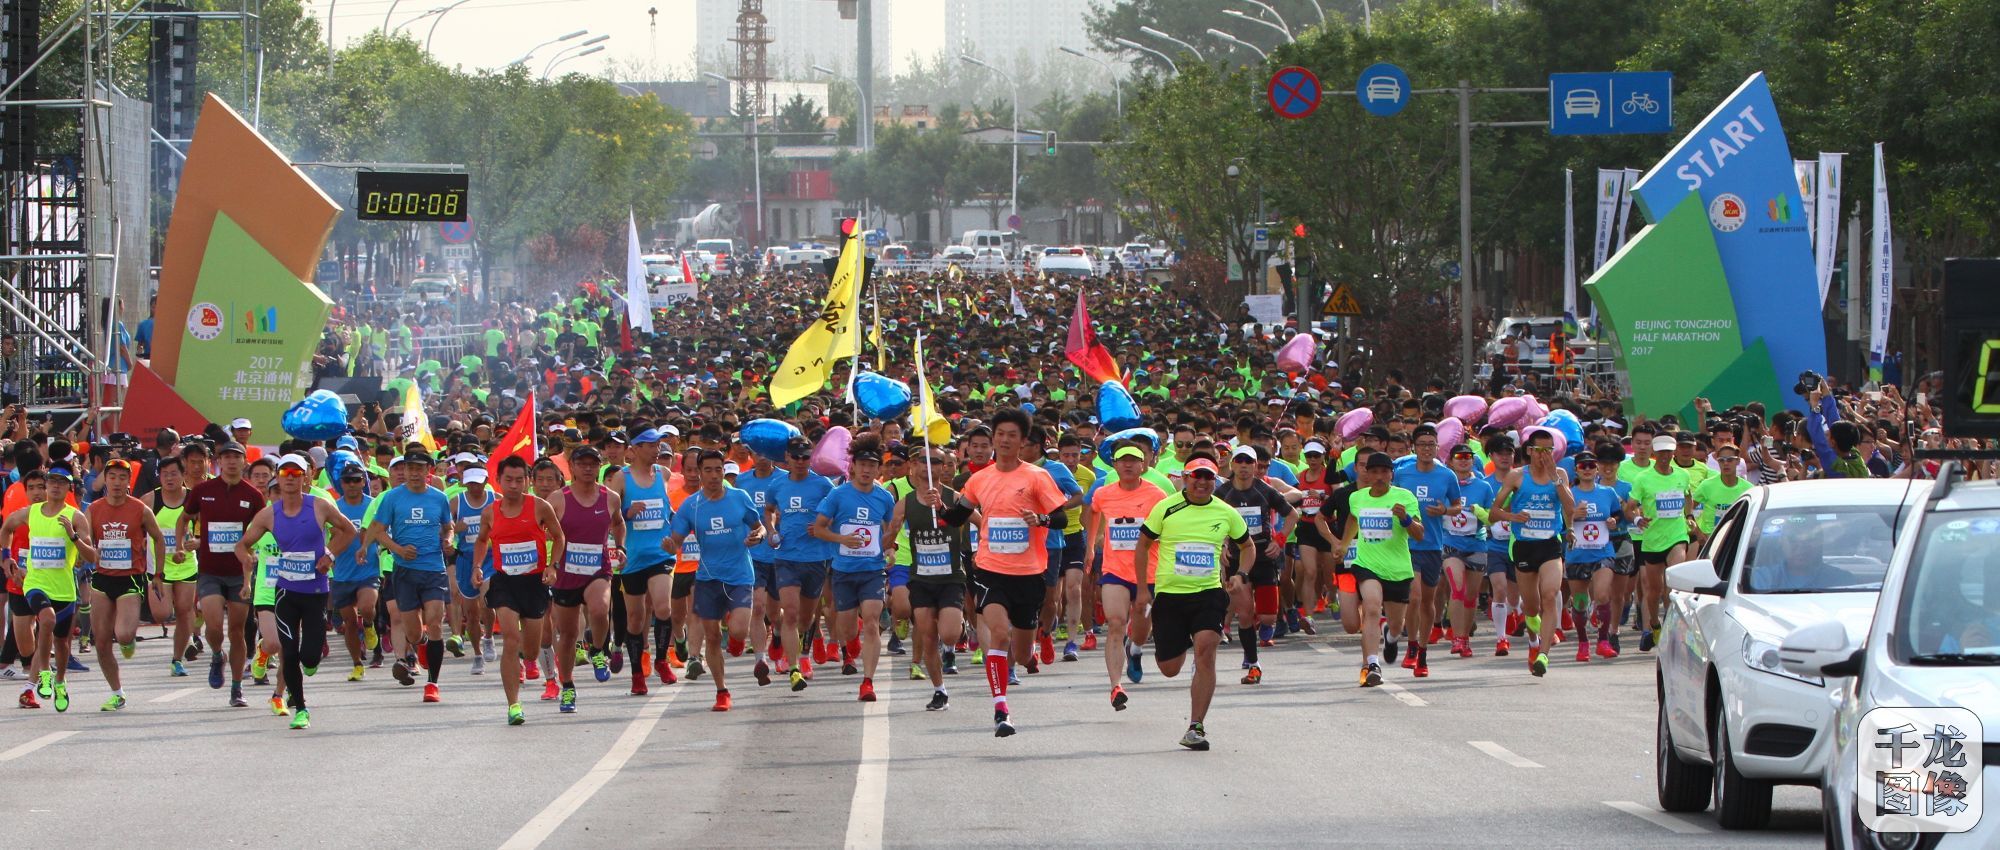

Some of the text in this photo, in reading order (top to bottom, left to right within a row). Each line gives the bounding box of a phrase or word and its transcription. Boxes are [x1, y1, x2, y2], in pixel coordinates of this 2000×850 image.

[1676, 105, 1765, 191] START
[366, 191, 459, 216] 0:00:08
[1634, 319, 1732, 331] BEIJING TONGZHOU
[1633, 332, 1720, 342] HALF MARATHON
[1631, 346, 1653, 356] 2017
[249, 356, 283, 369] 2017
[233, 369, 293, 385] 北京通州
[218, 386, 292, 402] 半程马拉松
[1361, 518, 1389, 528] A10165
[705, 527, 732, 535] salomon
[991, 530, 1024, 540] A10155
[1112, 529, 1140, 538] A10102
[212, 533, 239, 542] A00135
[33, 548, 62, 558] A10347
[100, 549, 128, 559] A00230
[505, 553, 533, 564] A10121
[569, 553, 599, 565] A10149
[919, 554, 946, 564] A10110
[1180, 554, 1211, 565] A10283
[282, 560, 311, 572] A00120
